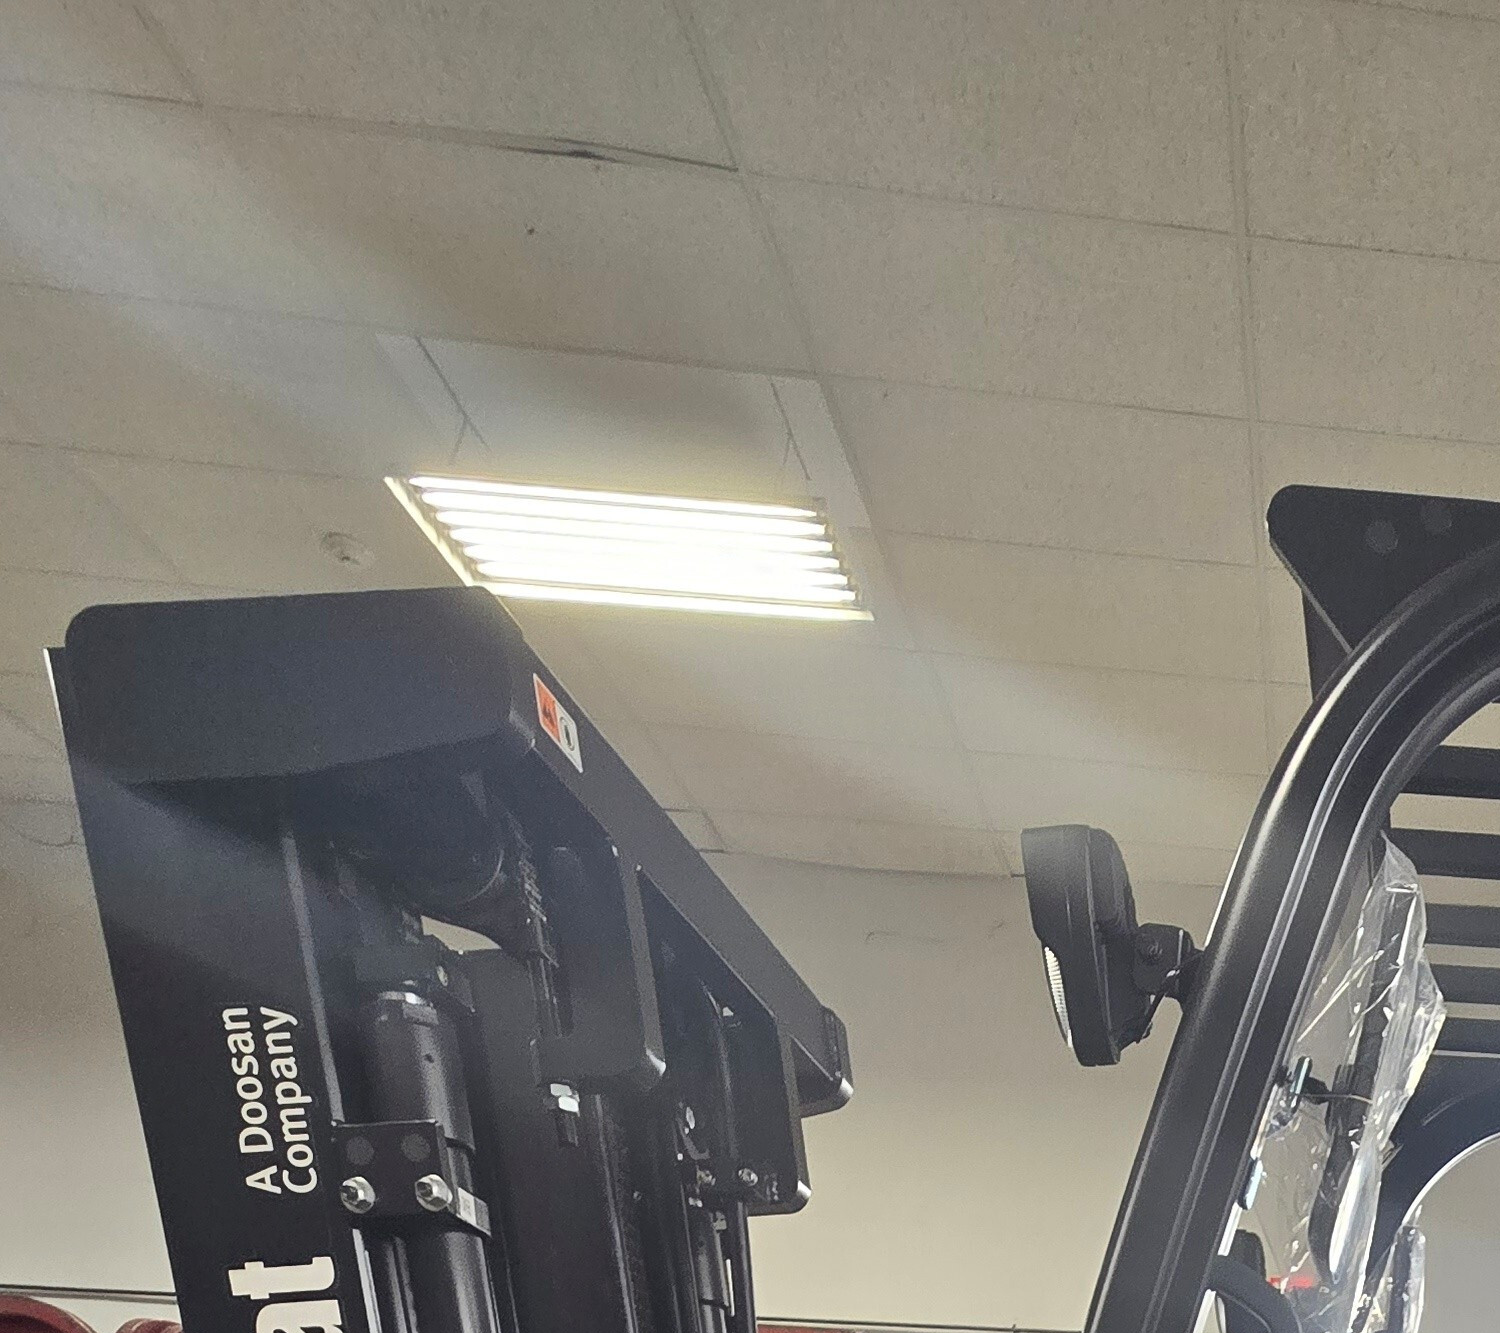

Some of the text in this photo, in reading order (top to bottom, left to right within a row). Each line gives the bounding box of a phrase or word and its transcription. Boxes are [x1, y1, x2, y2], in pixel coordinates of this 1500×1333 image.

[221, 1007, 282, 1195] A Doosan
[259, 1006, 318, 1194] Company
